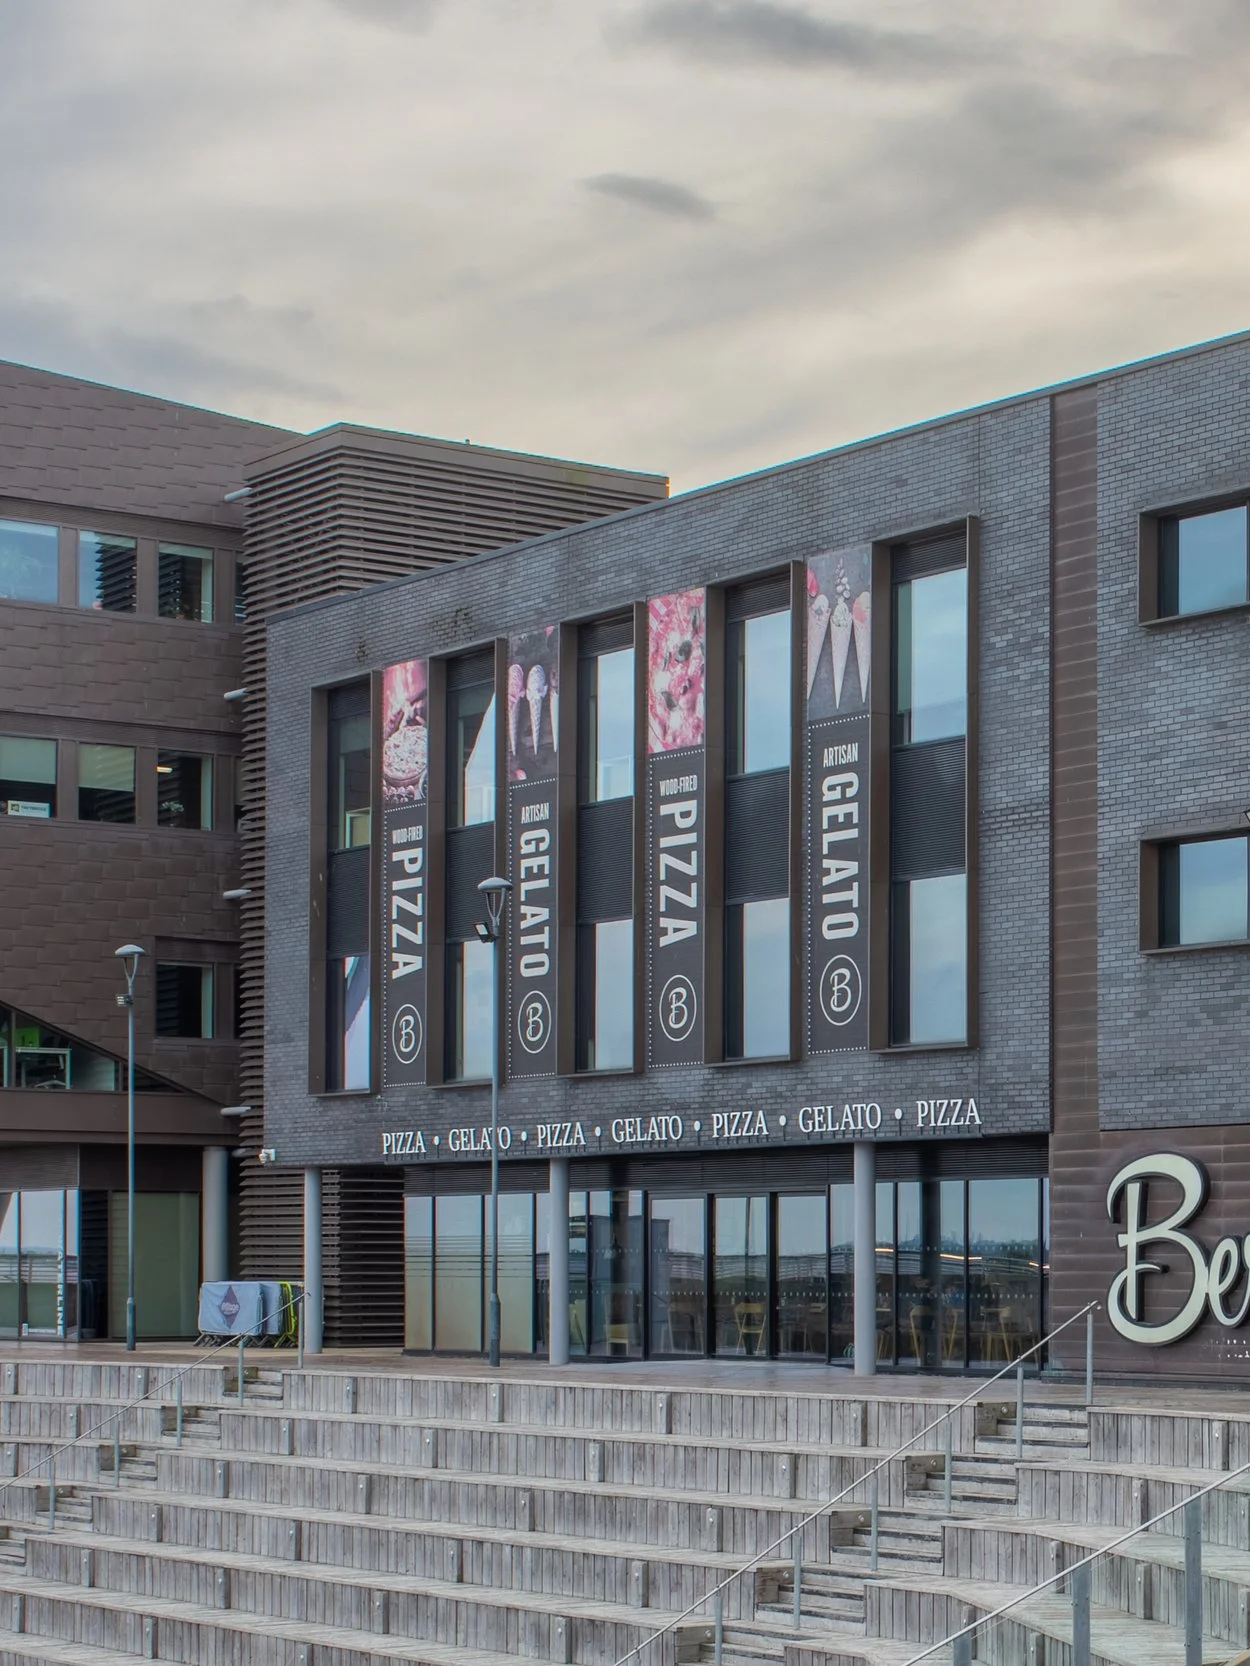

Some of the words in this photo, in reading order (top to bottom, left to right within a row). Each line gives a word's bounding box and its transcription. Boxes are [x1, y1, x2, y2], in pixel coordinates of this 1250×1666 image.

[822, 743, 859, 768] ARTISAN
[659, 775, 698, 797] WOOD-FIRED
[520, 802, 550, 824] ARTISAN
[392, 825, 423, 845] WOOD-FIRED
[822, 772, 859, 940] GELATO
[659, 800, 698, 948] PIZZA
[392, 847, 423, 980] PIZZA
[519, 828, 551, 978] GELATO
[668, 987, 689, 1029] B
[829, 967, 852, 1012] B
[399, 1015, 415, 1053] B
[526, 1002, 544, 1042] B
[382, 1130, 426, 1155] PIZZA
[536, 1121, 586, 1148] PIZZA
[611, 1115, 683, 1143] GELATO
[711, 1109, 769, 1138] PIZZA
[798, 1103, 883, 1133] GELATO
[916, 1097, 983, 1128] PIZZA
